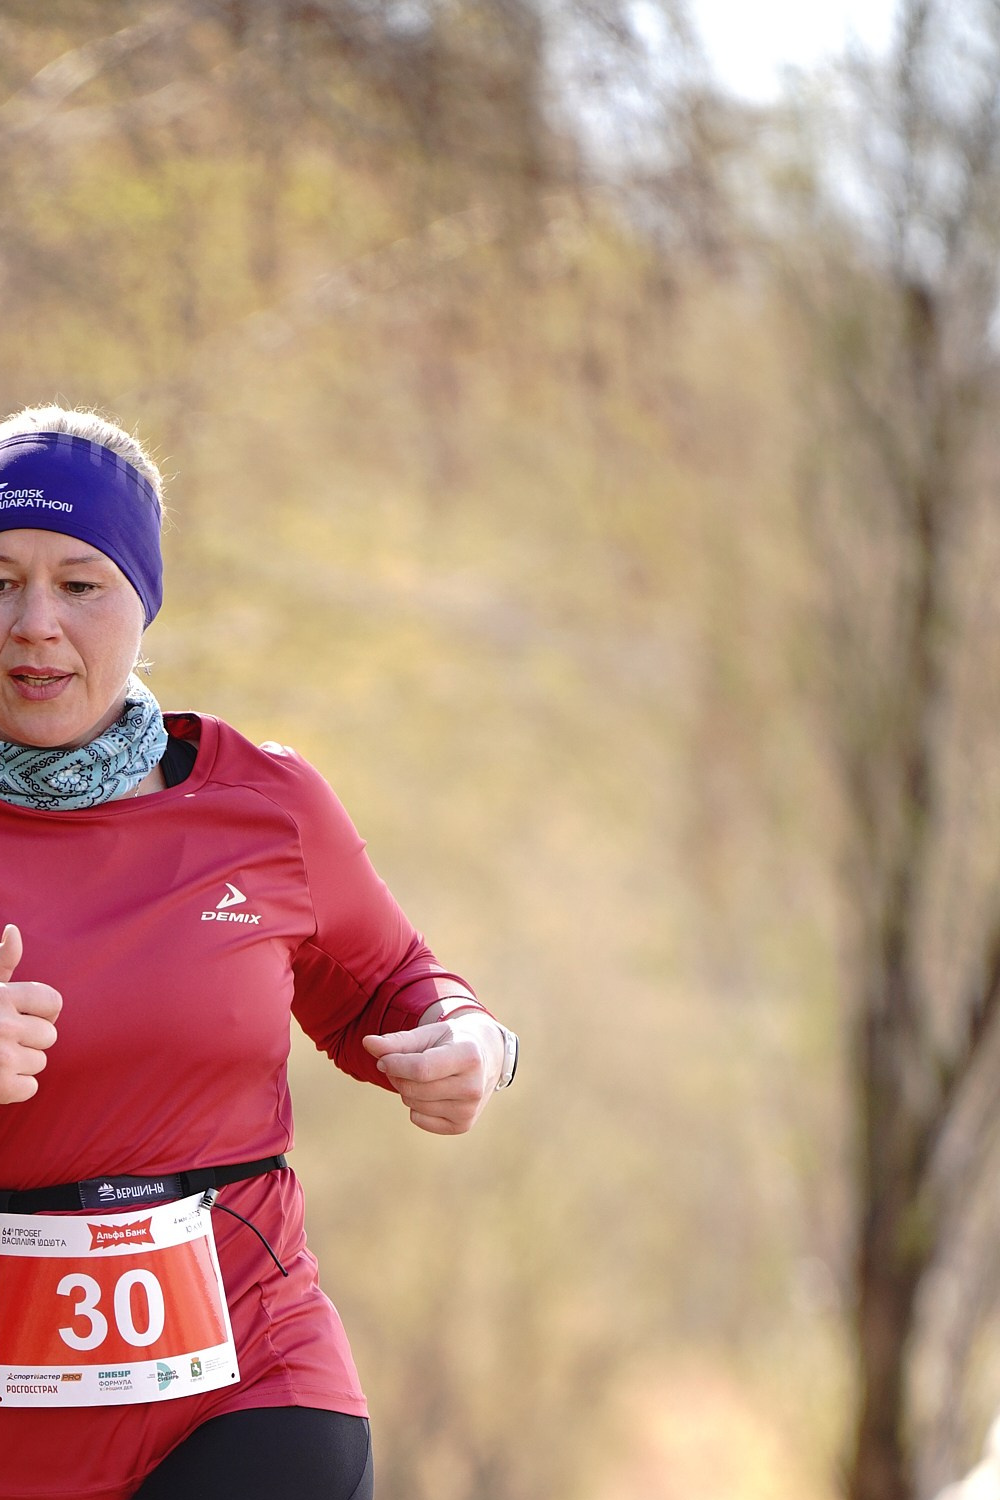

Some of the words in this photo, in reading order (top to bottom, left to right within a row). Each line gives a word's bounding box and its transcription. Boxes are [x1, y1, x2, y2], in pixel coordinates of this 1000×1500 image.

[201, 911, 262, 925] DEMIX
[116, 1182, 165, 1199] ВЕРШИНЫ
[14, 1228, 41, 1238] ПРОБЕГ
[97, 1230, 125, 1242] Альфа
[125, 1228, 147, 1237] Банк
[2, 1236, 36, 1246] ВАСИЛИЯ
[56, 1268, 165, 1351] 30
[61, 1373, 82, 1381] PRO
[98, 1370, 131, 1379] СИБУР
[98, 1379, 132, 1387] ФОРМУЛА
[6, 1384, 59, 1394] РОСГОССТРАХ
